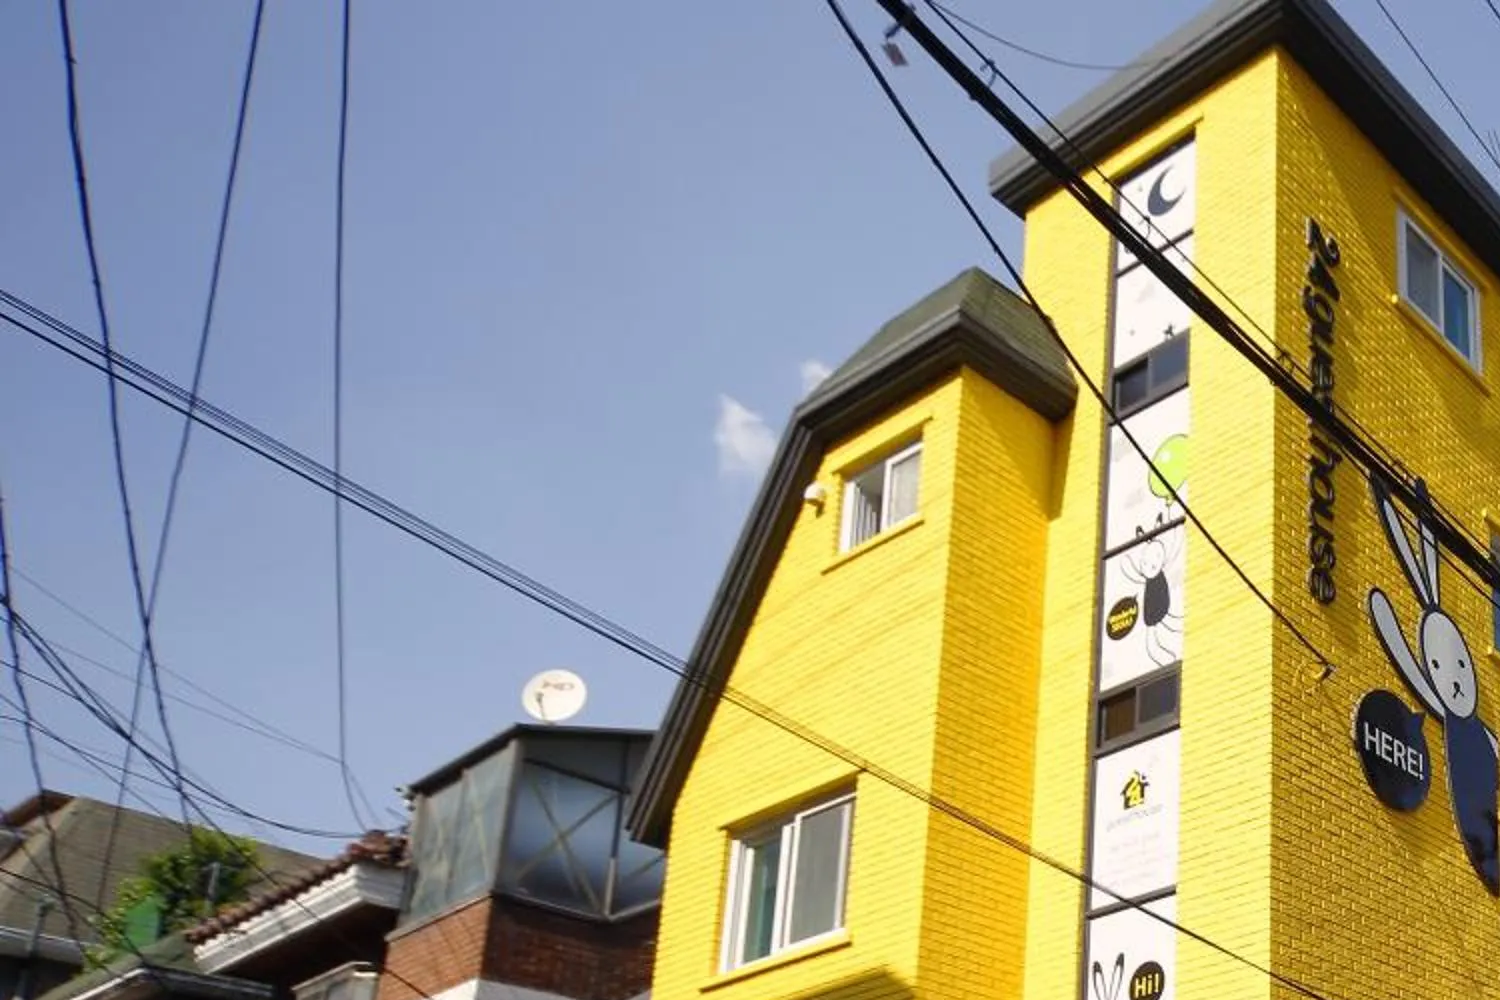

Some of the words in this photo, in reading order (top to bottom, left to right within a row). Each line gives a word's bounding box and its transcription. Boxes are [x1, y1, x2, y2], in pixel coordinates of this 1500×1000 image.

[1302, 285, 1336, 430] gues
[1308, 428, 1343, 606] house
[1363, 721, 1425, 781] HERE!
[1134, 972, 1160, 999] Hi!
